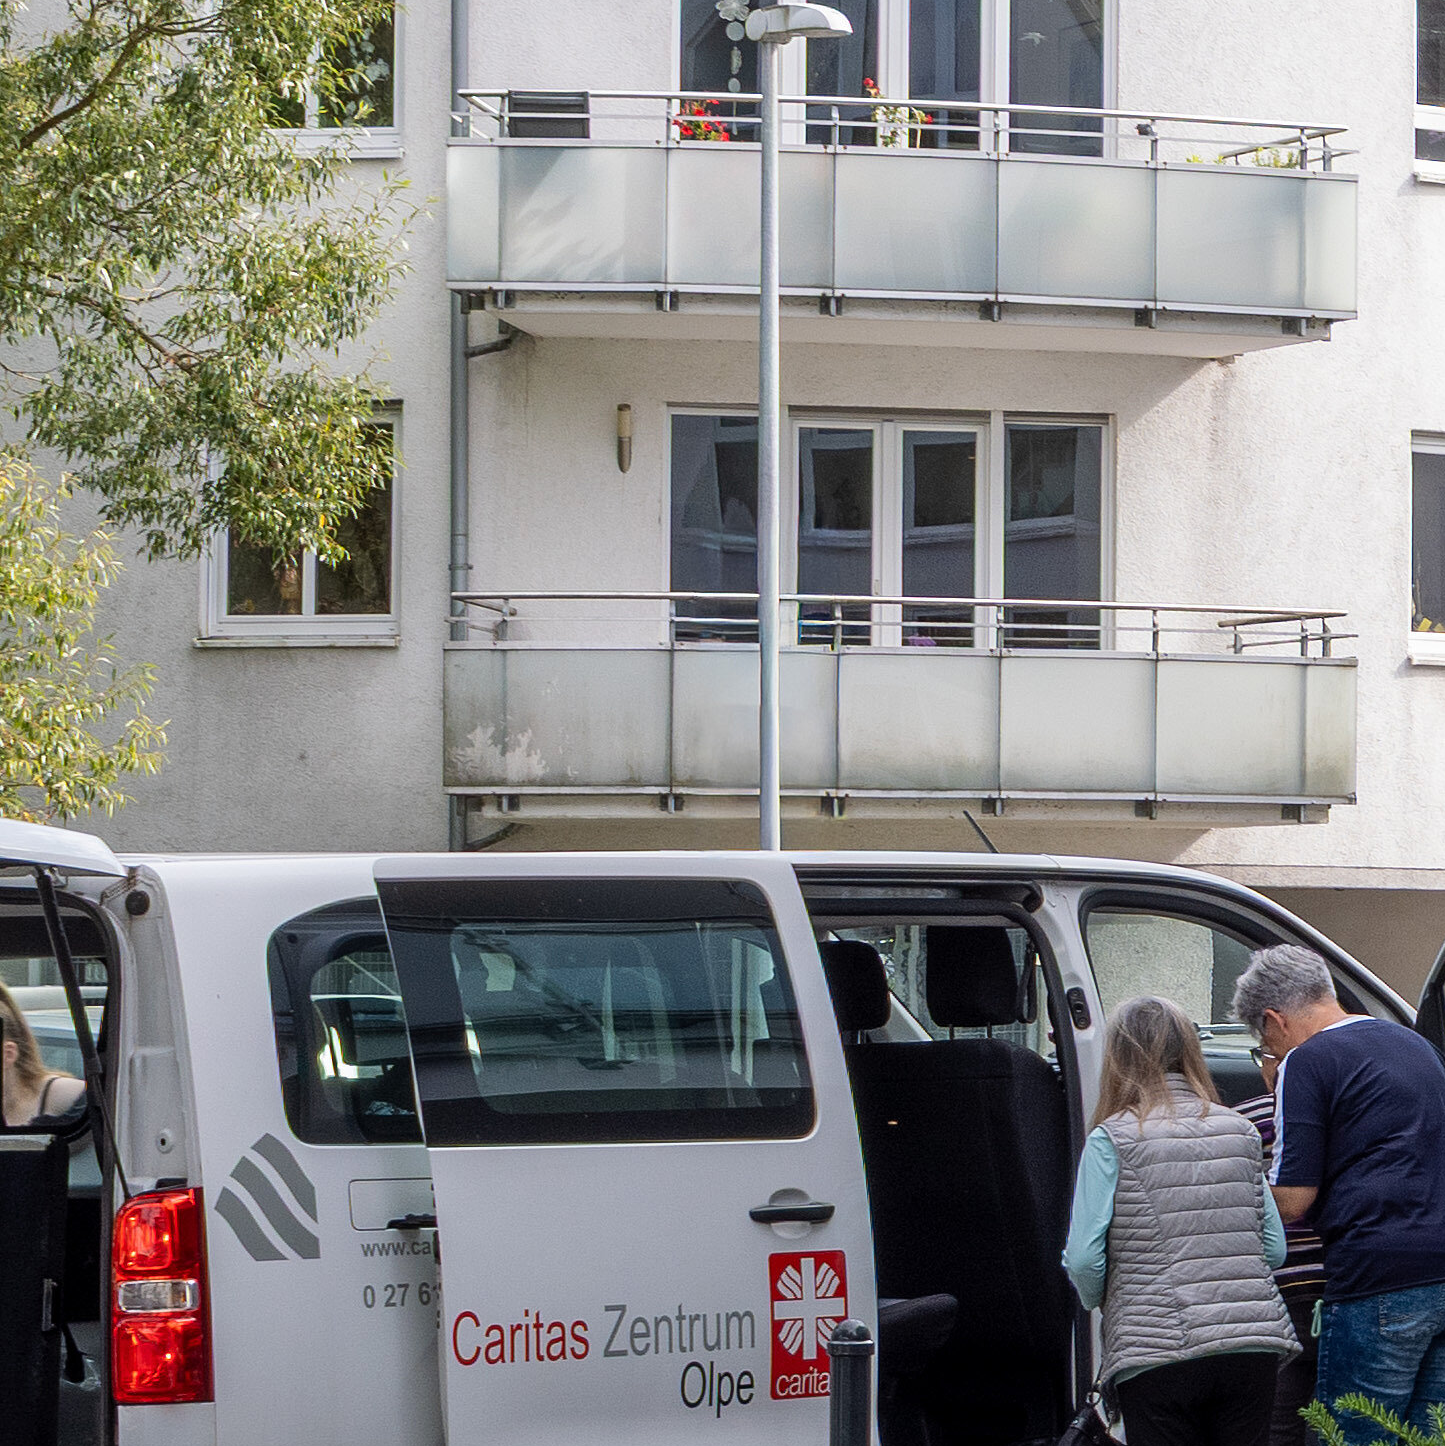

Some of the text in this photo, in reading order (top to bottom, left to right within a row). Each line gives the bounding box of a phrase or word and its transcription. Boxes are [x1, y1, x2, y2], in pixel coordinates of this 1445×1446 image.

[363, 1284, 376, 1308] 0
[383, 1283, 410, 1308] 27
[452, 1304, 757, 1368] Caritas Zentrum
[681, 1361, 755, 1418] Olpe
[776, 1365, 831, 1396] carita
